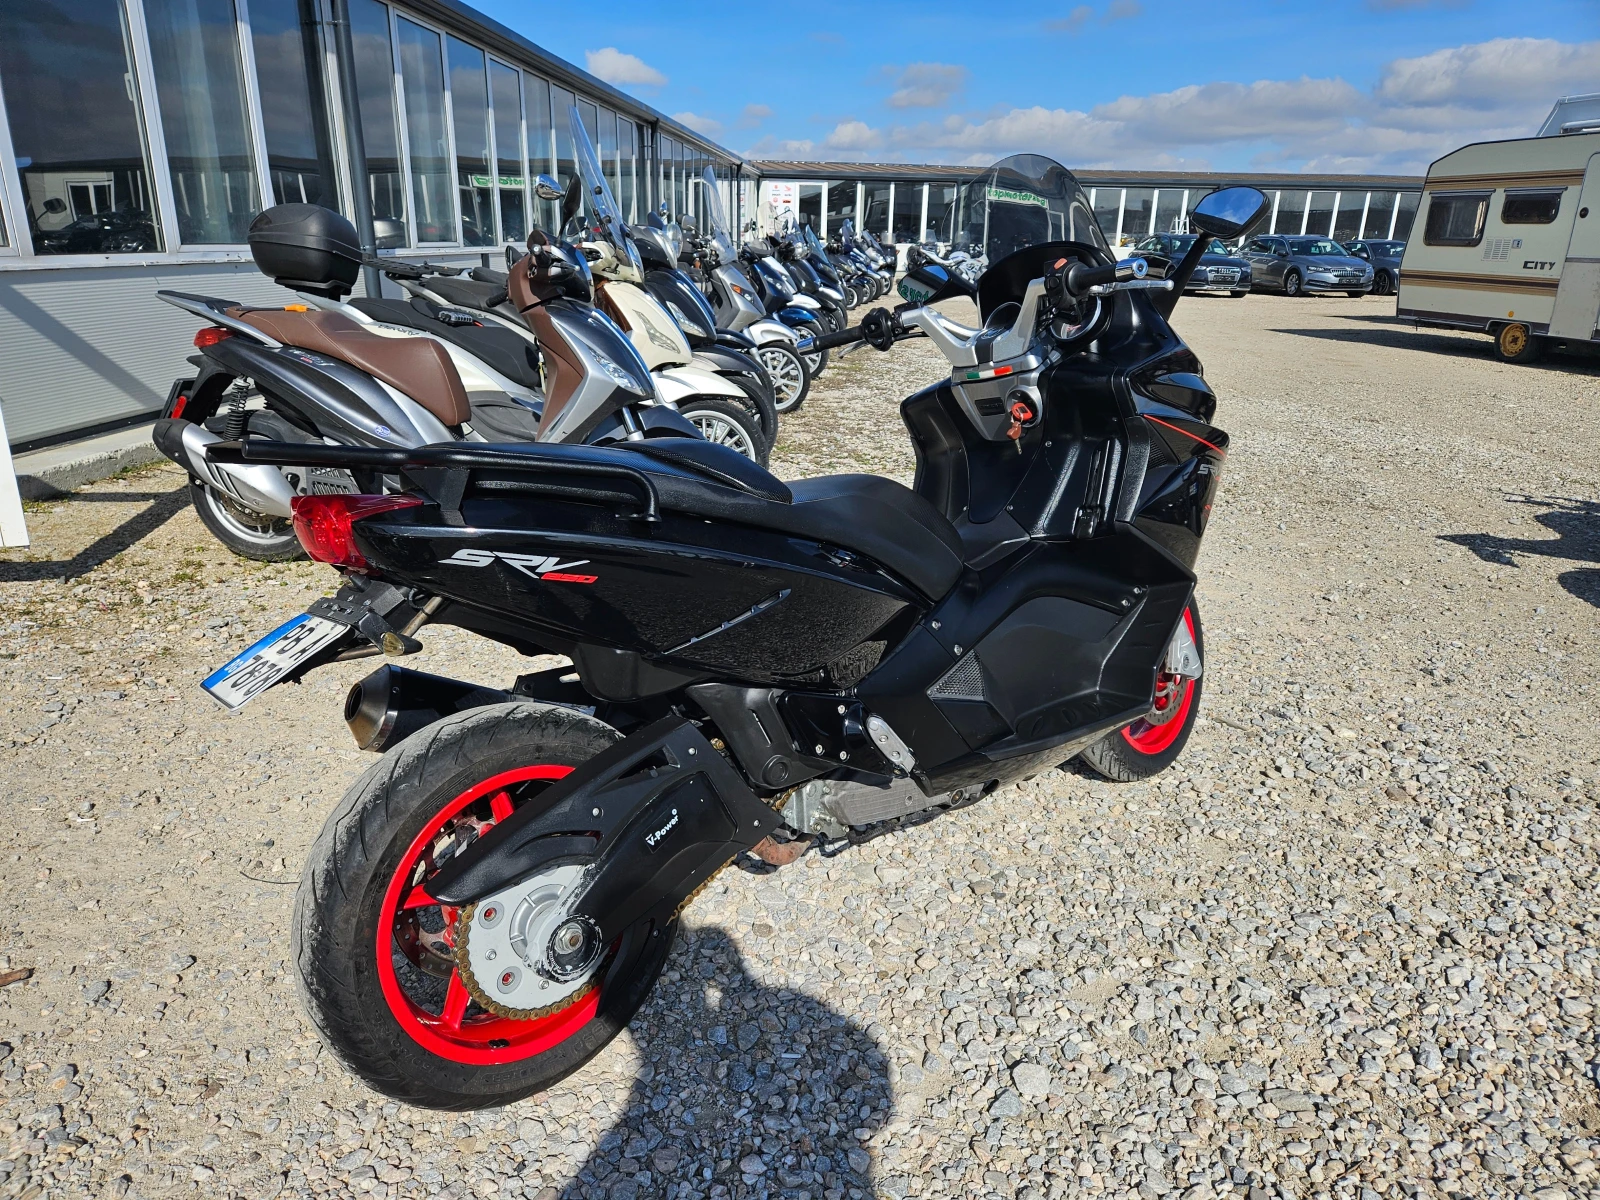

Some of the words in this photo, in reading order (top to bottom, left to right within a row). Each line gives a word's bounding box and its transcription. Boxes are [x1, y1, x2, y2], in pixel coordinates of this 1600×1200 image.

[1523, 261, 1556, 270] CITY
[437, 548, 591, 579] SRV
[268, 623, 315, 655] PB
[289, 633, 330, 662] A
[222, 654, 283, 697] 7878
[224, 658, 244, 674] BG
[645, 814, 679, 846] V-Power
